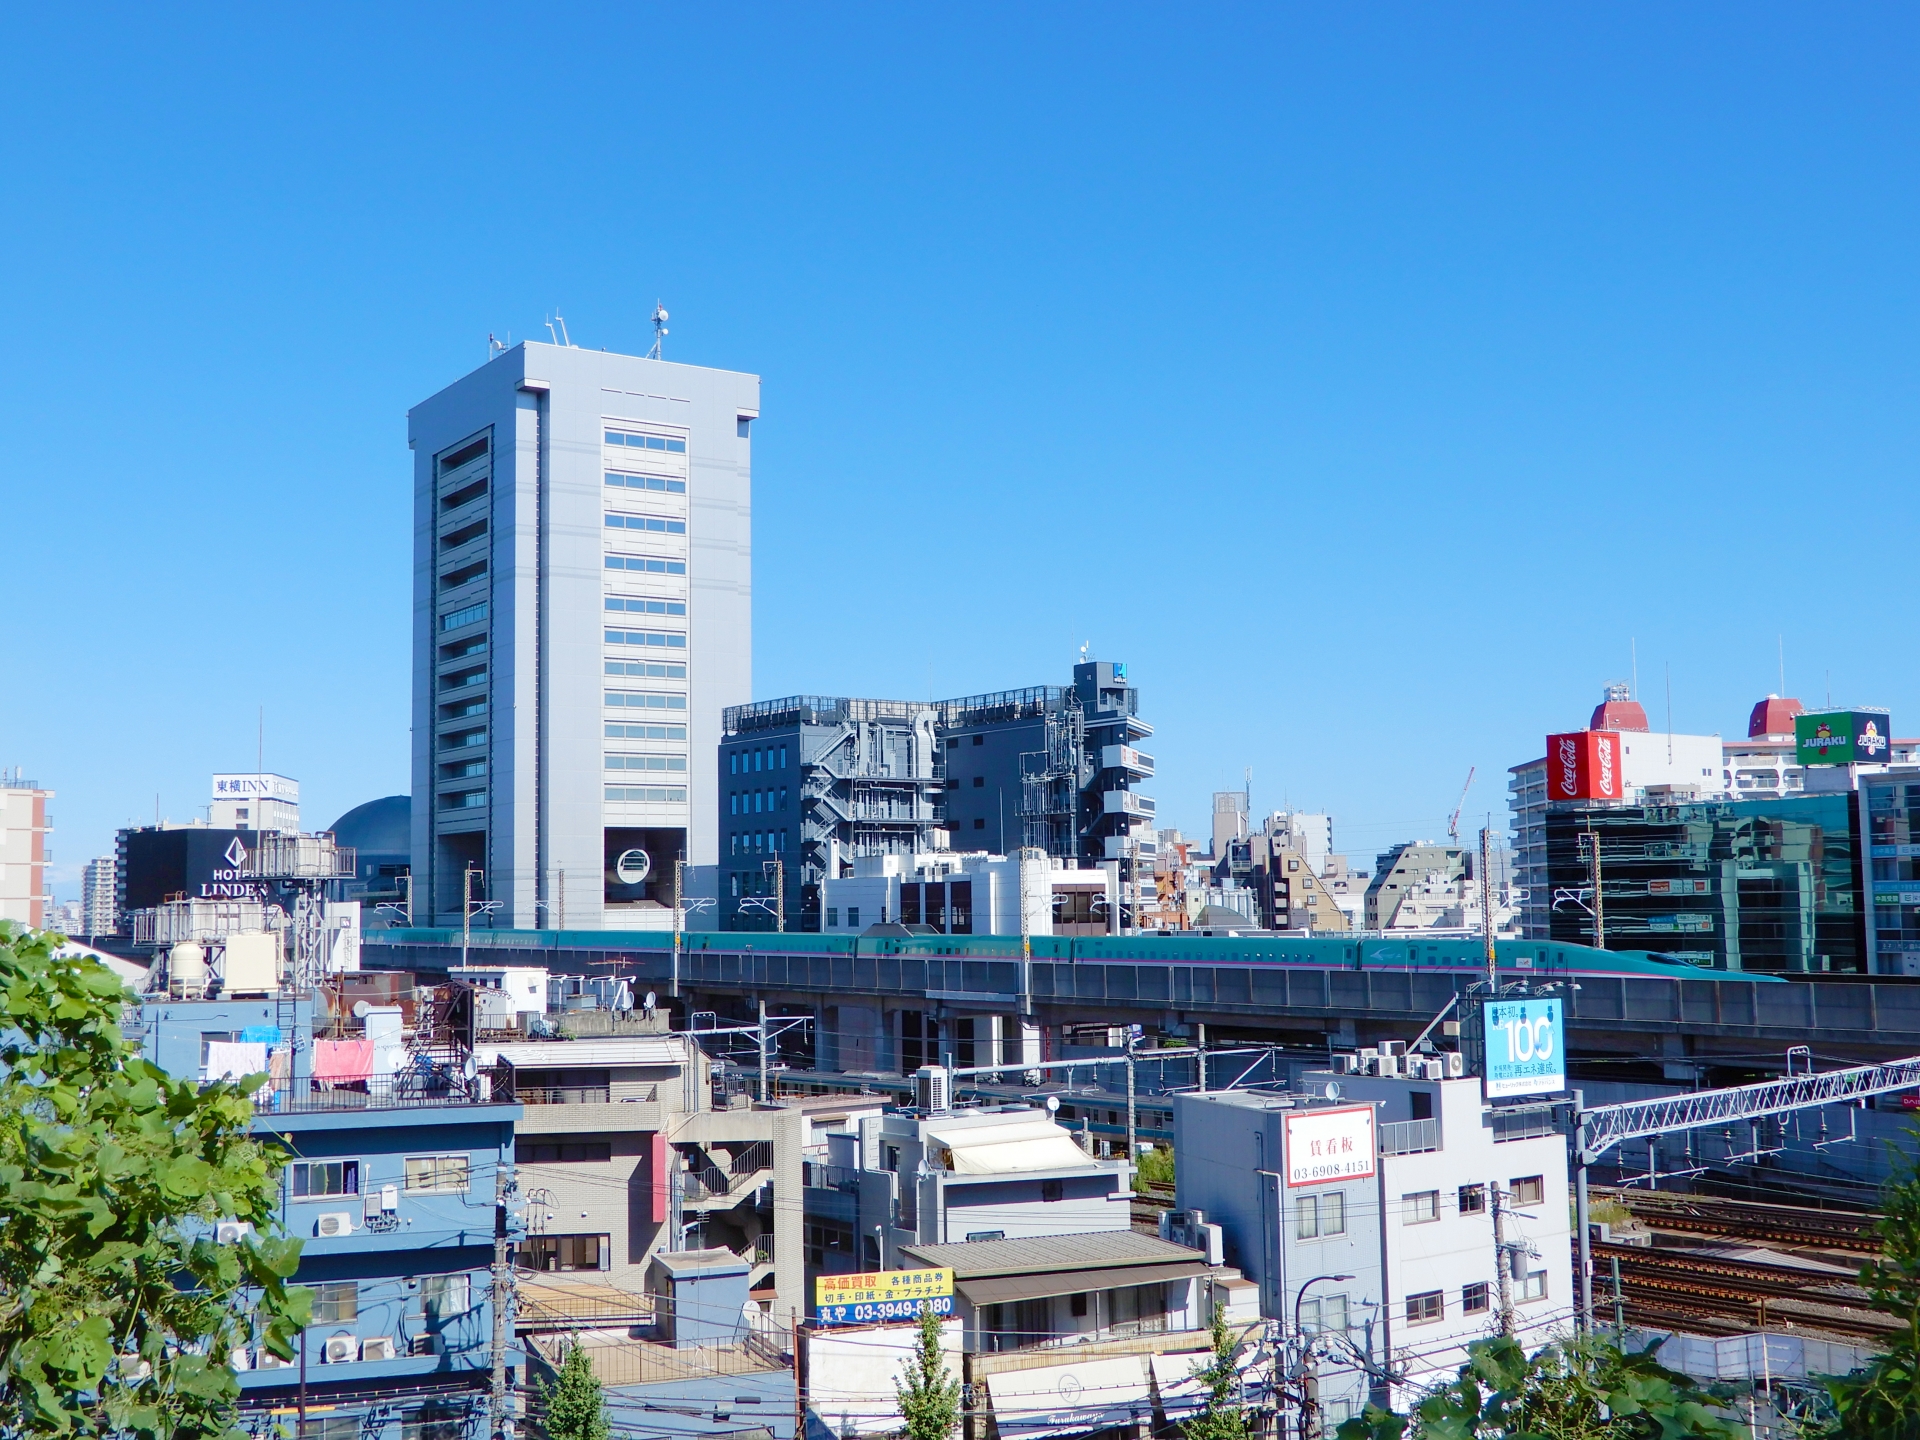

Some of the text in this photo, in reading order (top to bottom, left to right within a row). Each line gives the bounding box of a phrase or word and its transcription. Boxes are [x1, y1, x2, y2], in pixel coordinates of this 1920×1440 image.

[1803, 736, 1846, 748] JURAKU
[1858, 735, 1886, 747] JURAKU
[216, 779, 269, 793] 東横INN
[201, 883, 268, 897] LINDEN
[1505, 1016, 1554, 1063] 100
[1293, 1160, 1370, 1180] 03-6908-4151
[823, 1272, 943, 1291] 高価買取 各種商品券
[820, 1297, 951, 1323] 丸や 03-3949-8080
